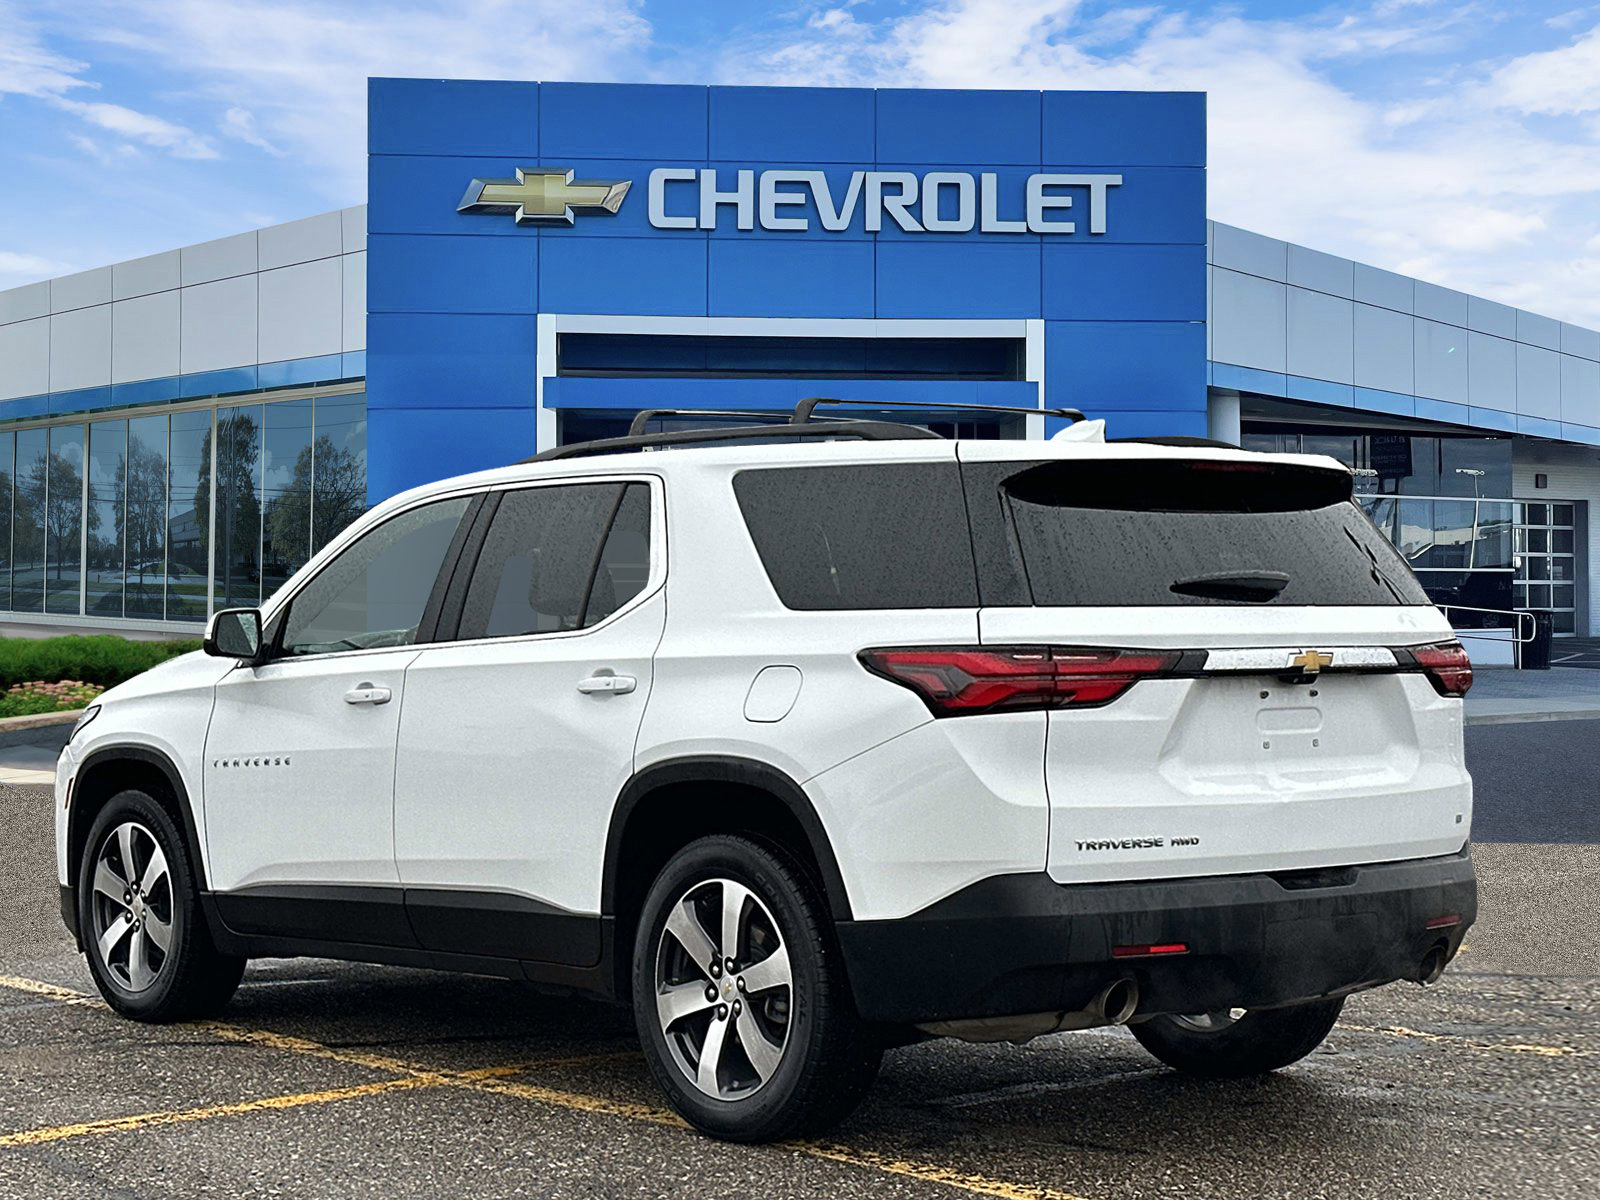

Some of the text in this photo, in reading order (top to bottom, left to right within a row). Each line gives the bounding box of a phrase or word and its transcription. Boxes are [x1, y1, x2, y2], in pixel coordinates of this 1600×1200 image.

[648, 167, 1123, 234] CHEVROLET
[1074, 837, 1200, 851] TRAVERSE AWD
